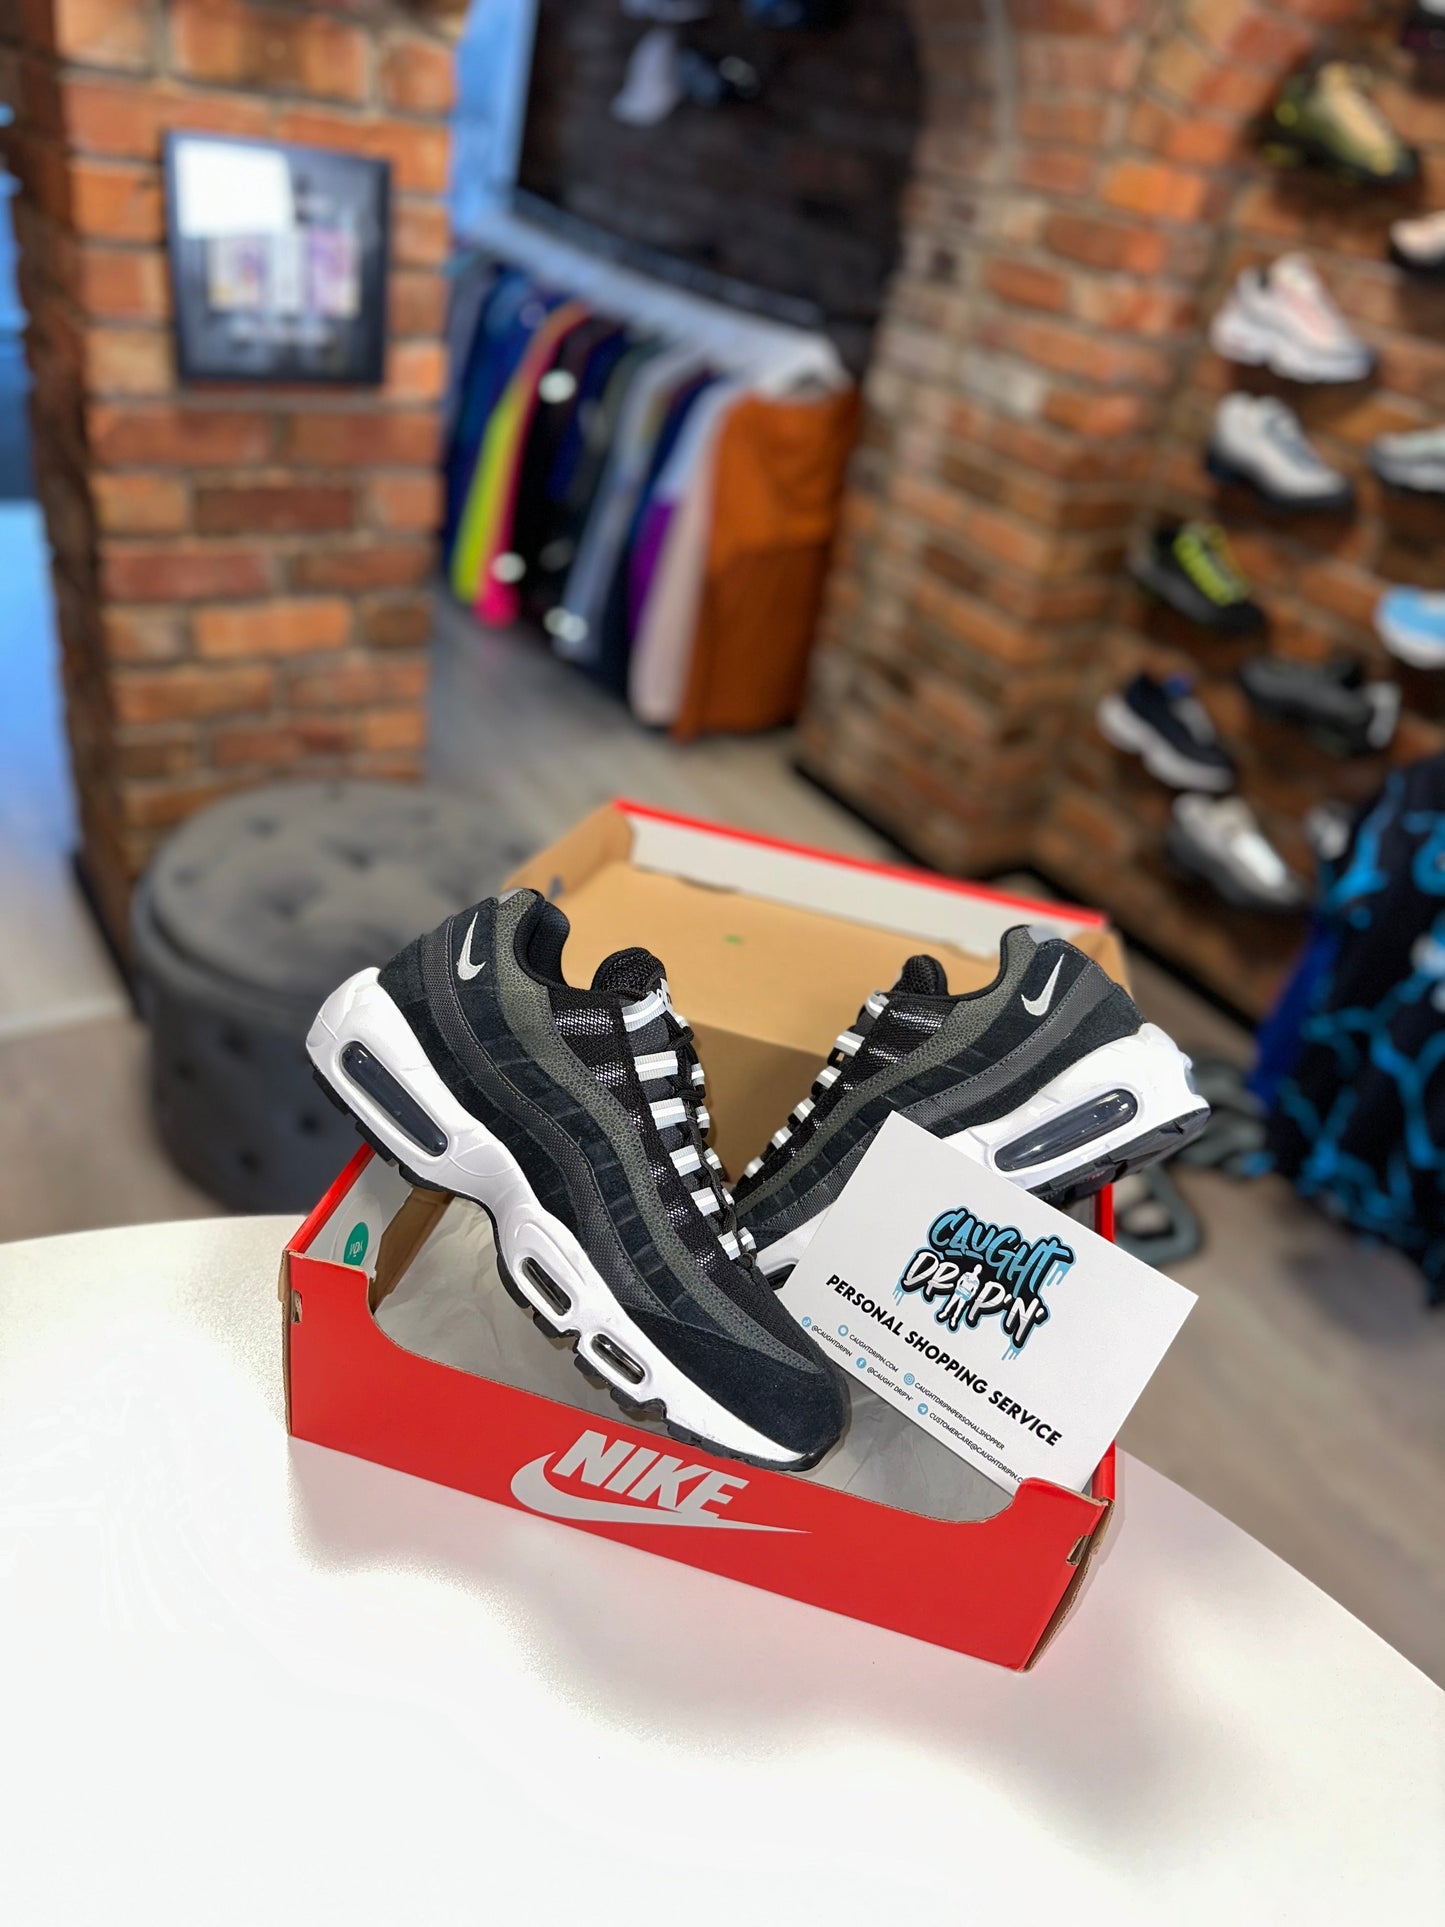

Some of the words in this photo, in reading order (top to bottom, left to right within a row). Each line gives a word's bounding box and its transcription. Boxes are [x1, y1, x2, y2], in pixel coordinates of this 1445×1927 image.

[931, 1209, 1070, 1298] CAUGHT
[811, 1325, 853, 1357] @CAUGHTDRIPIN
[866, 1366, 895, 1388] @CAUGHT
[826, 1274, 904, 1336] PERSONAL
[904, 1330, 988, 1394] SHOPPING
[988, 1390, 1063, 1447] SERVICE
[849, 1334, 899, 1373] CAUGHTDRIPIN.COM
[914, 1382, 1006, 1451] CAUGHTDRIPINPERSONALSHOPPER
[551, 1429, 750, 1520] NIKE
